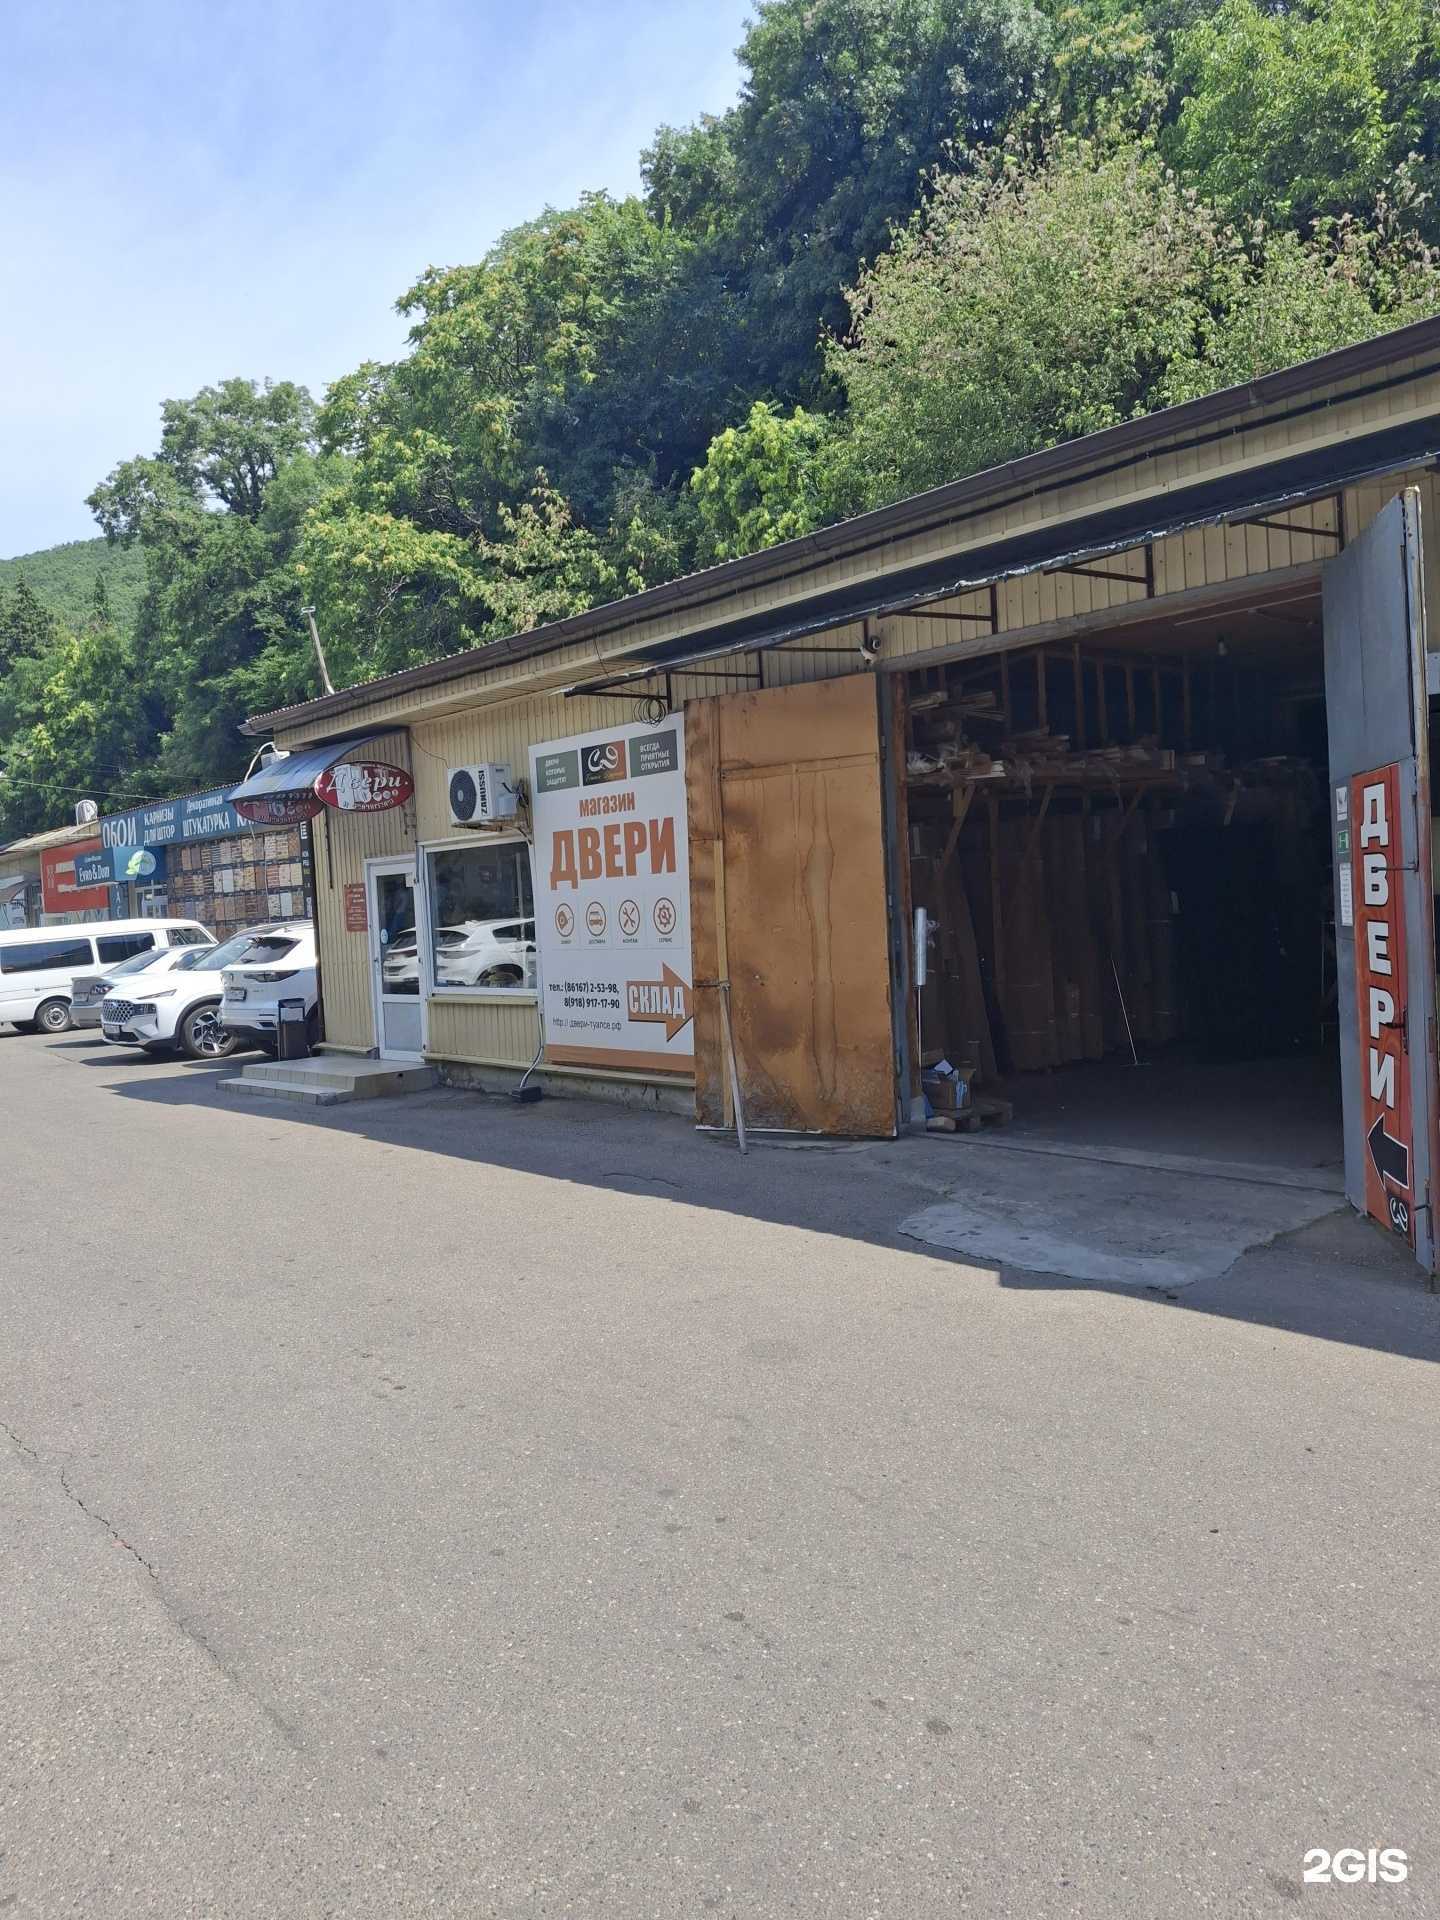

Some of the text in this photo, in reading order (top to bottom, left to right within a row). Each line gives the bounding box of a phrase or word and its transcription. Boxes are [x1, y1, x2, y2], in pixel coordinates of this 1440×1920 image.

[639, 742, 661, 753] ВСЕГДА
[640, 750, 671, 762] ПРИЯТНЫЕ
[640, 759, 671, 771] ОТКРЫТИЯ
[478, 770, 488, 815] ZANUSSI
[579, 792, 636, 818] магазин
[143, 807, 174, 827] КАРНИЗЫ
[182, 811, 230, 837] ШТУКАТУРКА
[102, 817, 137, 849] ОБОИ
[549, 817, 677, 891] ДВЕРИ
[1360, 782, 1396, 1110] ДВЕРИ
[549, 980, 620, 995] тел.: (86167) 2-53-98,
[564, 996, 620, 1009] 8(918) 917-17-90
[629, 985, 686, 1019] СКЛАД
